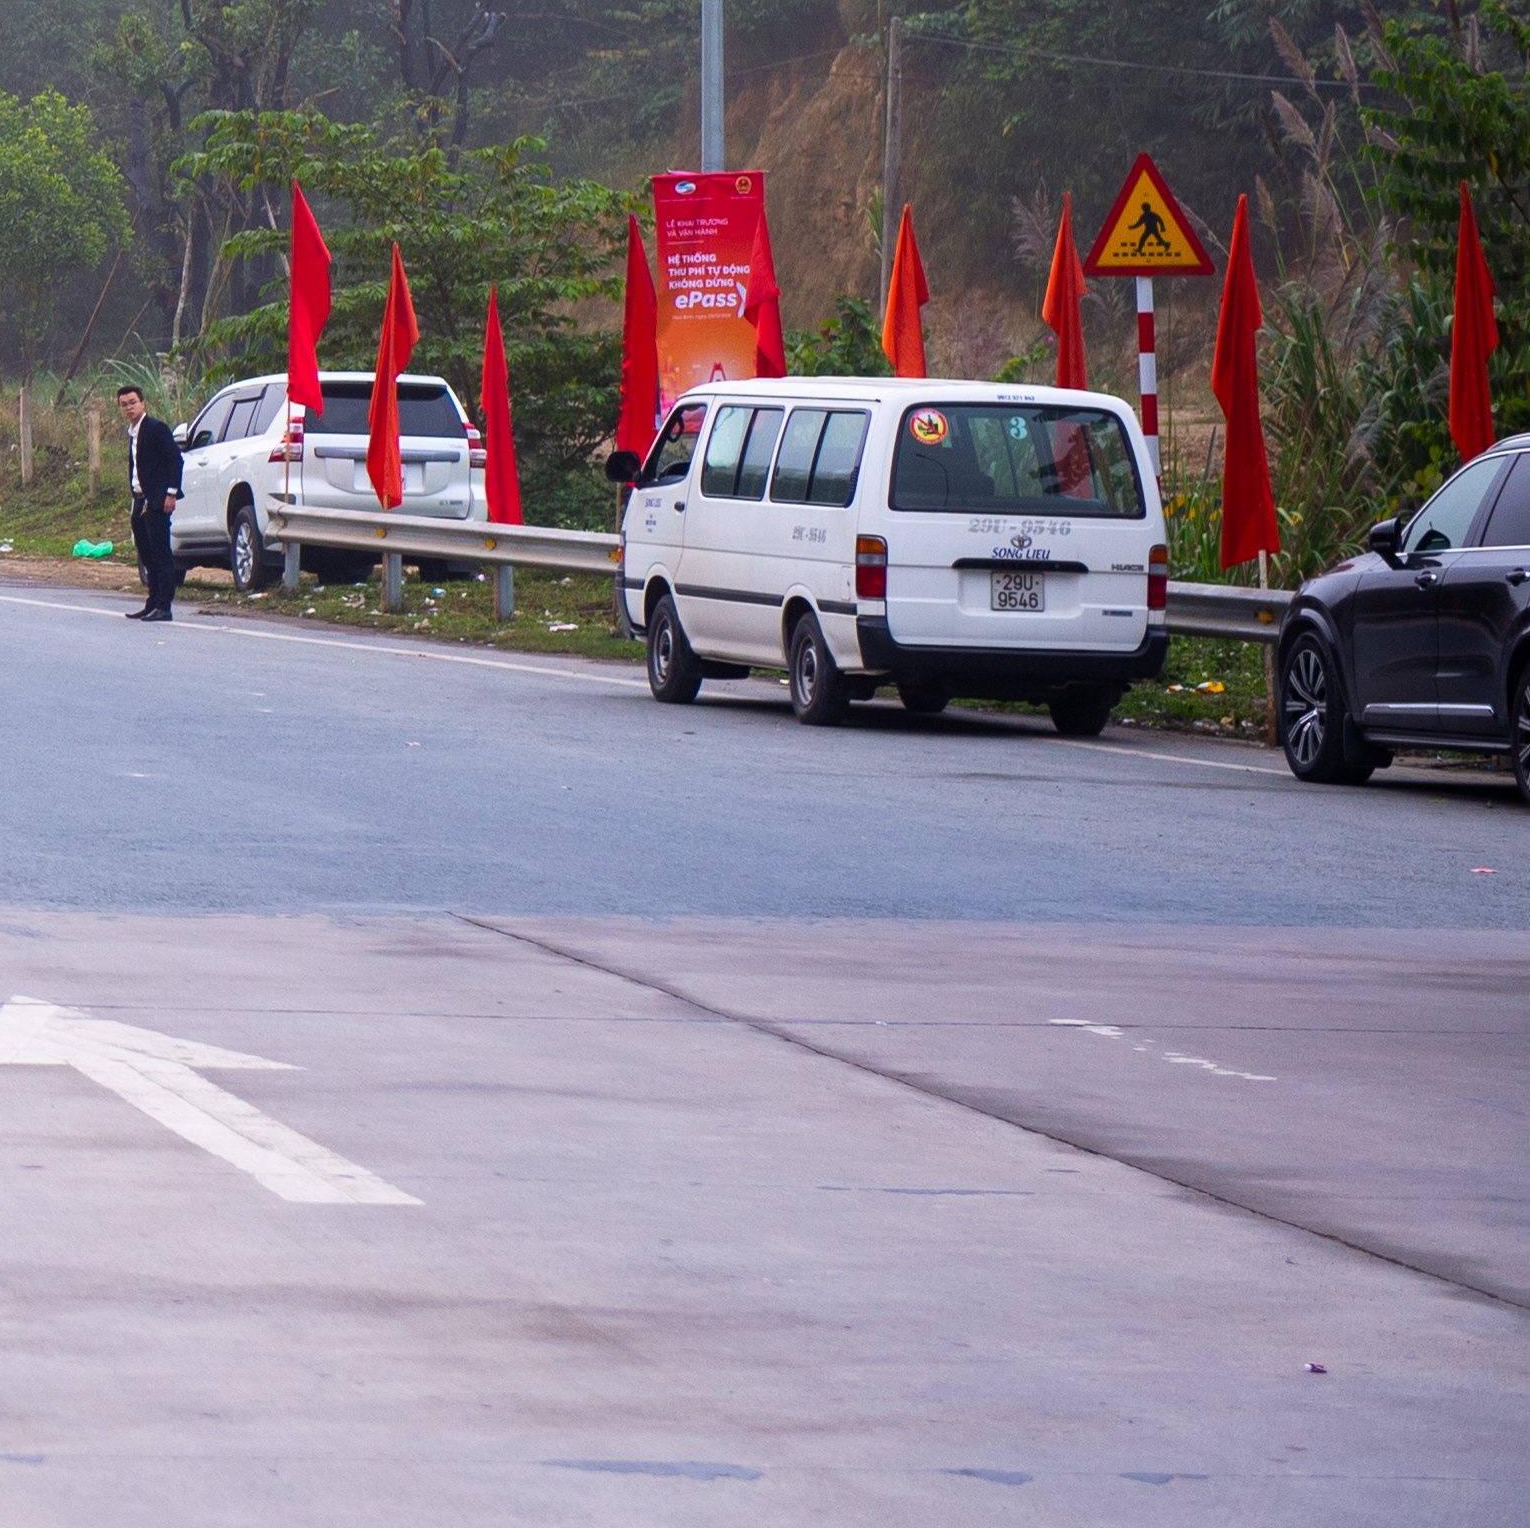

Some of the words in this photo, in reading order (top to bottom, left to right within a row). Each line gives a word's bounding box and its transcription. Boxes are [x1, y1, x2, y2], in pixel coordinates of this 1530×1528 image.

[668, 268, 686, 277] THU
[688, 265, 705, 276] PHÍ
[669, 278, 704, 290] KHÔNG
[674, 291, 737, 309] ePass
[1009, 416, 1028, 440] 3
[992, 547, 1023, 559] SONG
[1025, 548, 1051, 560] LIEU
[1003, 575, 1034, 591] 29U
[998, 592, 1039, 608] 9546
